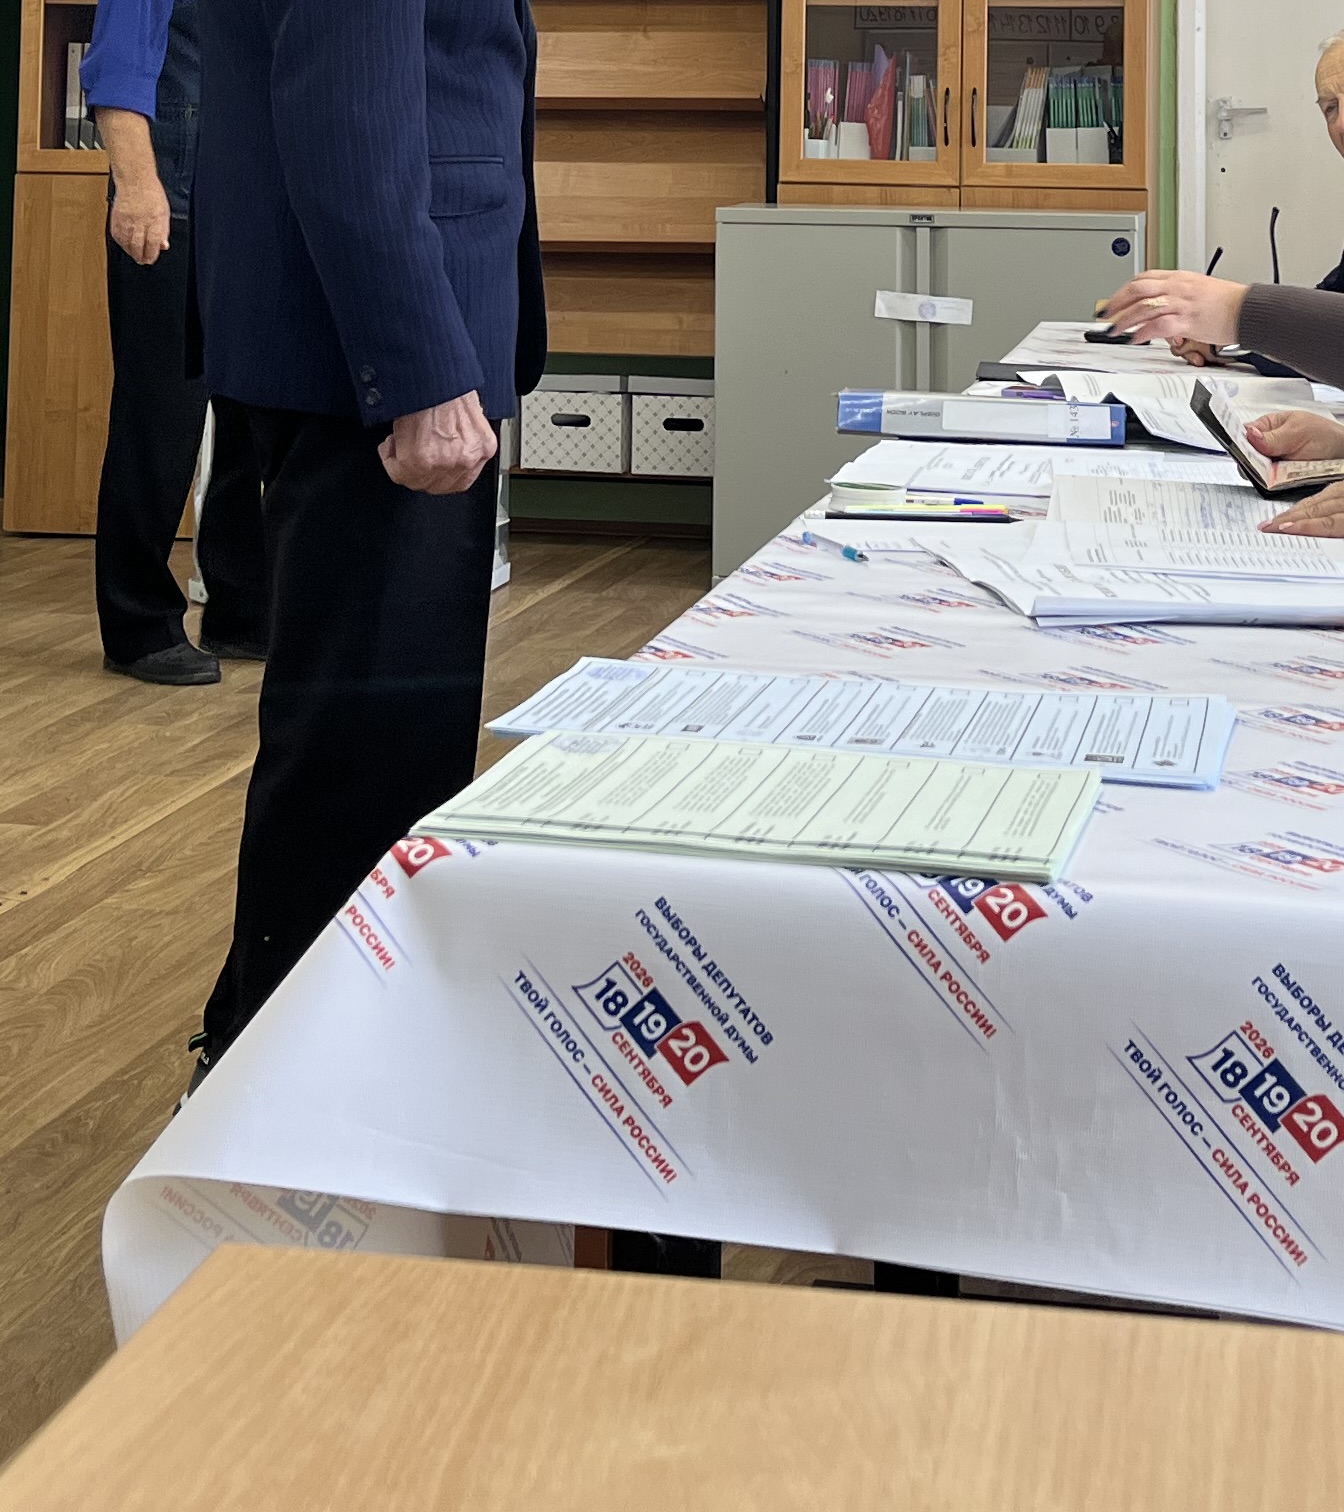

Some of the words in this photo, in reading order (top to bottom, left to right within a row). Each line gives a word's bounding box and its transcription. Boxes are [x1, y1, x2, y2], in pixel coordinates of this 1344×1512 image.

[928, 888, 991, 964] СЕНТЯБРЯ
[985, 888, 1029, 929] 20
[623, 951, 654, 988] 2026
[635, 908, 730, 1029] ГОСУДАРСТВЕННОЙ
[724, 1025, 759, 1064] ДУМЫ
[654, 895, 708, 962] ВЫБОРЫ
[702, 960, 774, 1046] ДЕПУТАТОВ
[858, 873, 901, 919] ГОЛОС
[907, 928, 942, 974] СИЛА
[940, 970, 997, 1039] РОССИИ!
[1272, 962, 1332, 1031] ВЫБОРЫ
[595, 977, 629, 1016] 18
[632, 1000, 668, 1040] 19
[668, 1027, 711, 1073] 20
[611, 1031, 673, 1108] СЕНТЯБРЯ
[1240, 1021, 1275, 1059] 2026
[514, 970, 550, 1014] ТВОЙ
[544, 1011, 585, 1062] ГОЛОС
[591, 1074, 625, 1119] СИЛА
[622, 1115, 678, 1183] РОССИИ!
[1211, 1047, 1248, 1089] 18
[1254, 1072, 1291, 1115] 19
[1291, 1101, 1338, 1149] 20
[1123, 1039, 1163, 1085] ТВОЙ
[1157, 1082, 1204, 1137] ГОЛОС
[1211, 1148, 1250, 1196] СИЛА
[1247, 1192, 1308, 1268] РОССИИ!
[1231, 1104, 1300, 1186] СЕНТЯБРЯ
